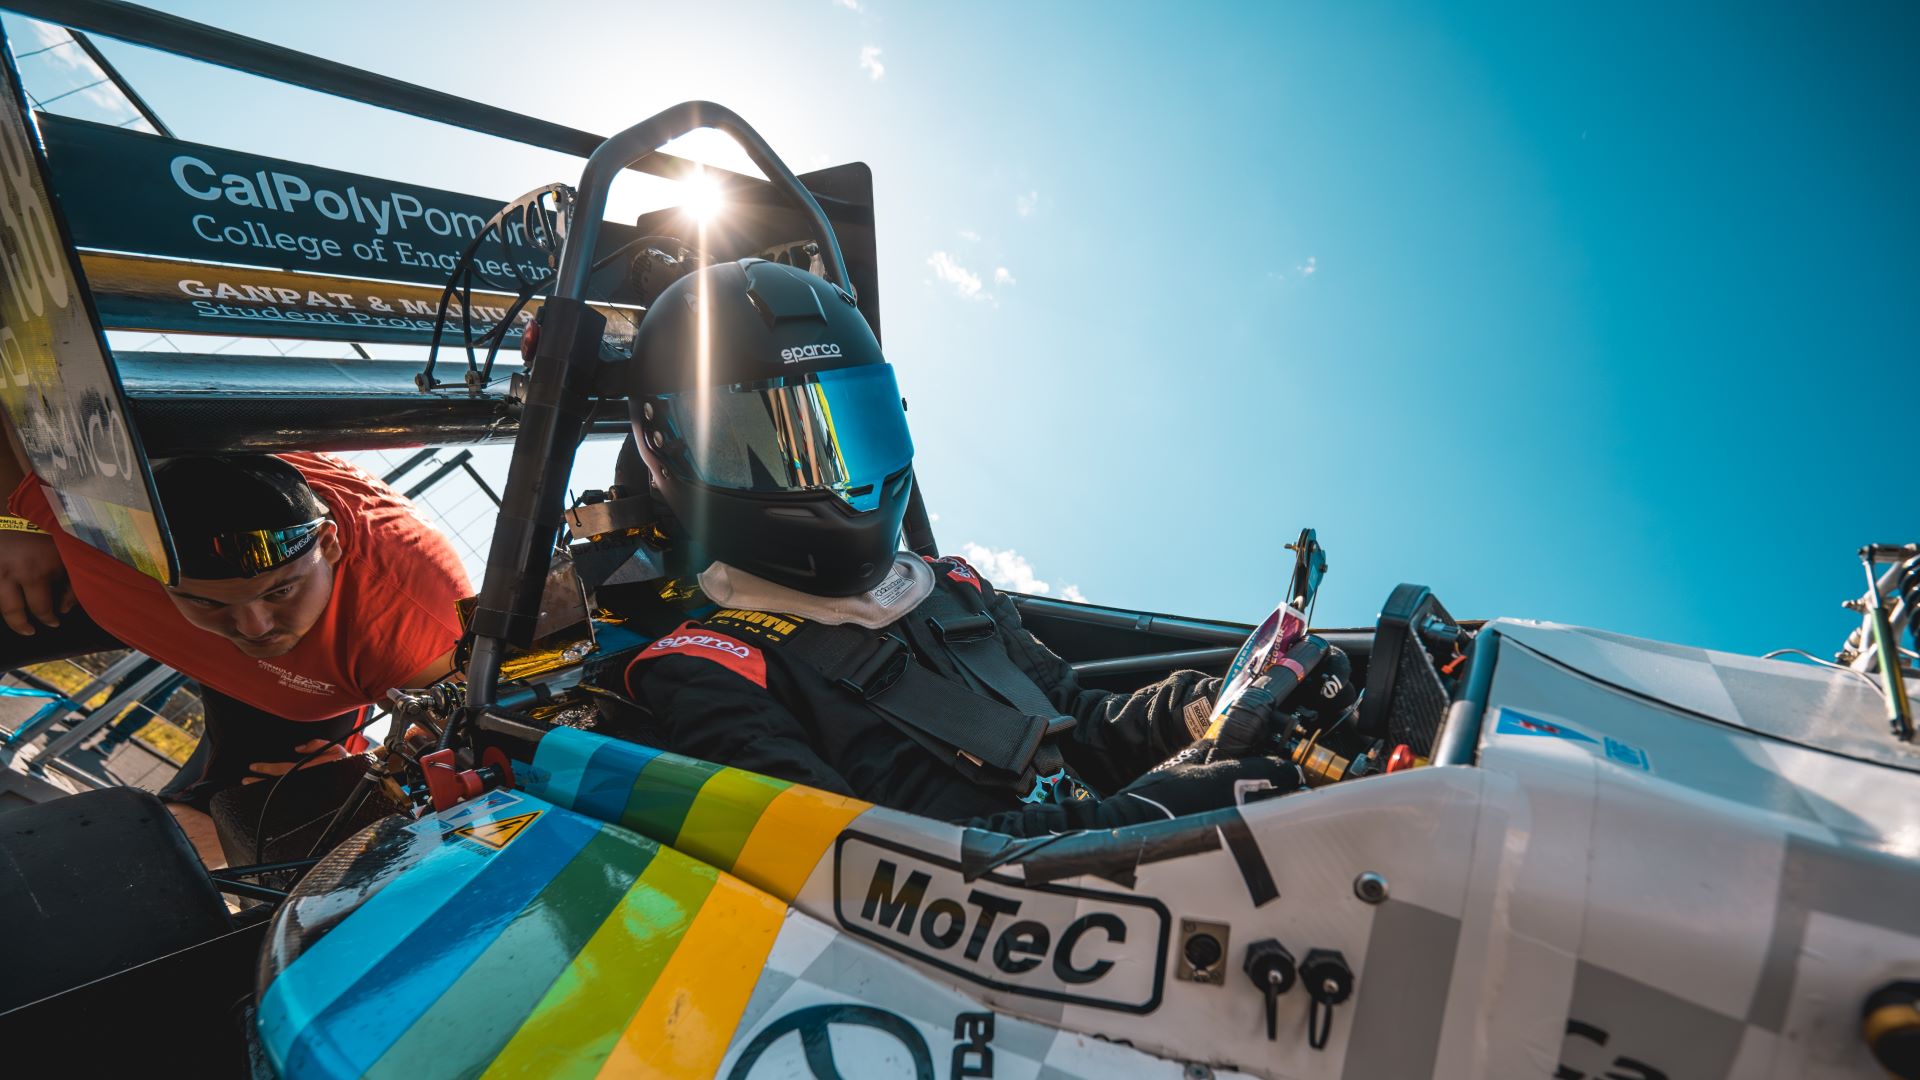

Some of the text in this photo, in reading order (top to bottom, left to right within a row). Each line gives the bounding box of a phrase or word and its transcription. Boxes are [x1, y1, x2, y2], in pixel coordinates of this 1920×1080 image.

[192, 214, 558, 281] College of Engneerin
[178, 279, 356, 310] GANPAT
[367, 296, 395, 312] &
[192, 300, 344, 325] Student
[781, 343, 842, 364] sparco
[653, 635, 750, 659] sparco
[861, 859, 1127, 984] MoTeC
